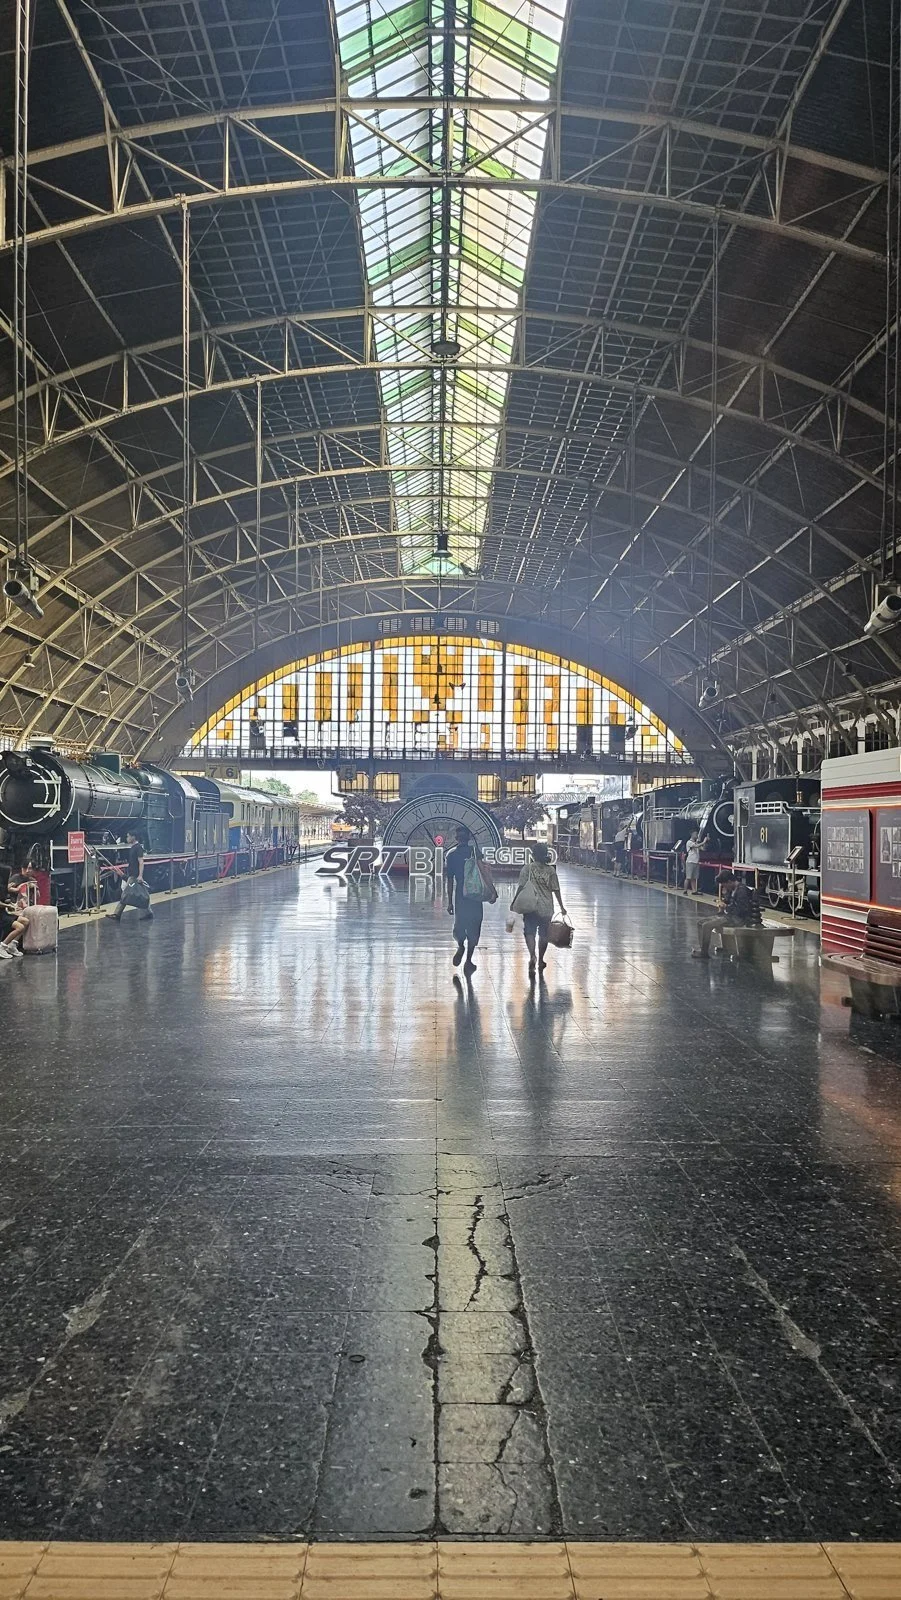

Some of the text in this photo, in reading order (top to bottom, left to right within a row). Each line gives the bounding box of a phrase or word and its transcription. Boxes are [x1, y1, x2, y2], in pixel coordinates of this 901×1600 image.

[209, 767, 218, 778] 7
[225, 767, 234, 778] 6
[434, 803, 448, 814] XII
[412, 808, 425, 822] XI
[396, 830, 408, 838] X
[314, 846, 411, 876] SRT
[482, 847, 558, 866] EGEND
